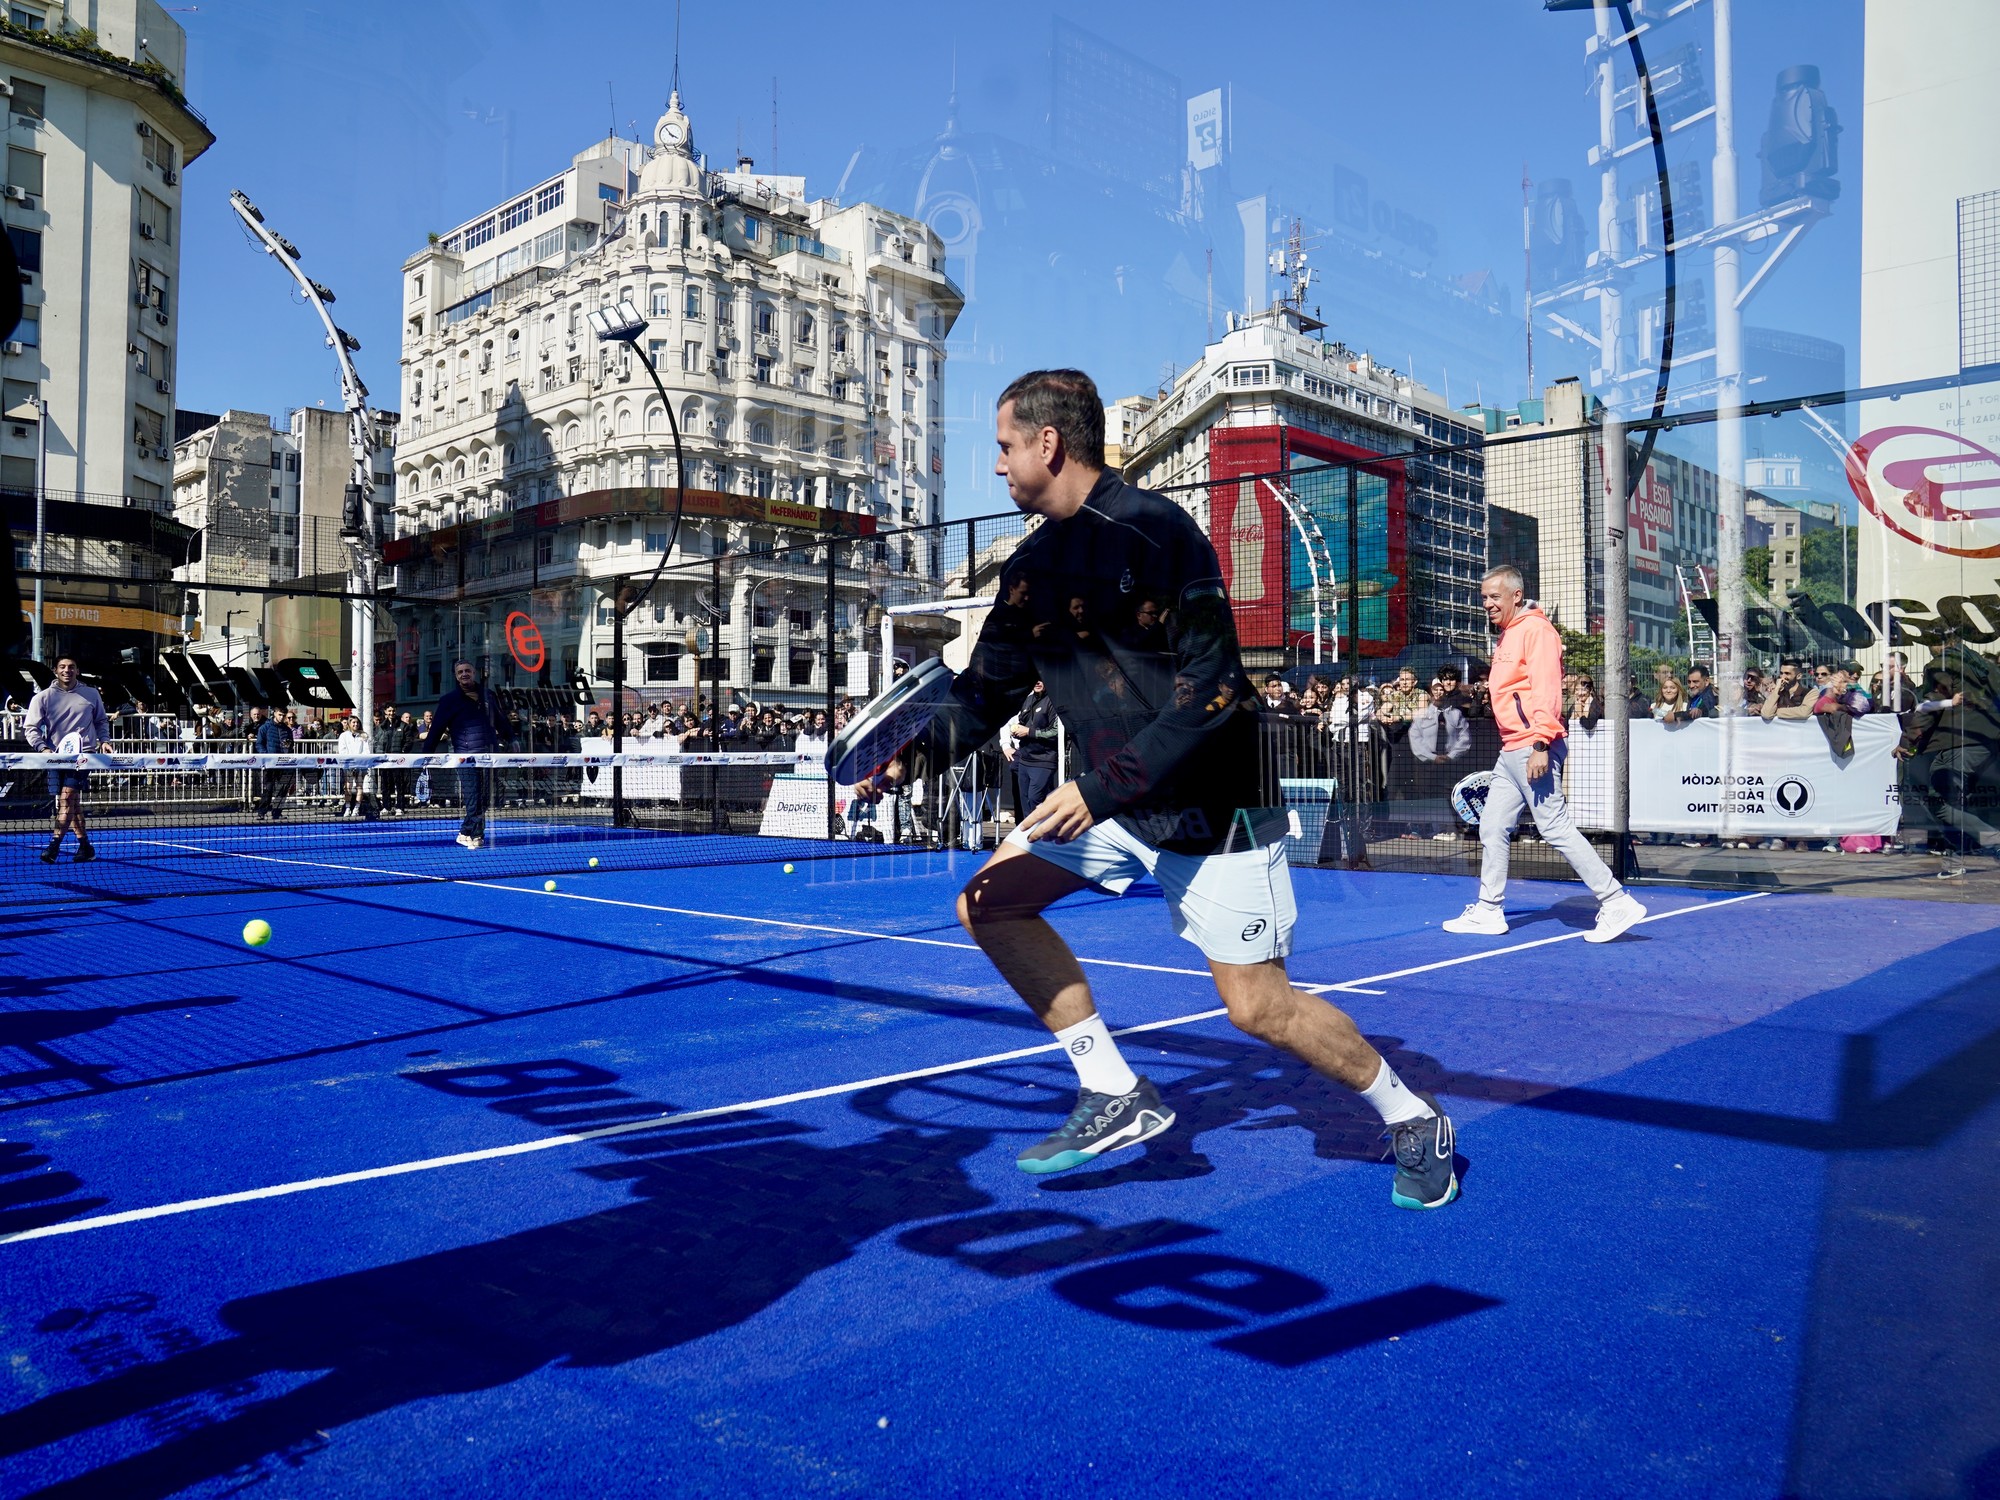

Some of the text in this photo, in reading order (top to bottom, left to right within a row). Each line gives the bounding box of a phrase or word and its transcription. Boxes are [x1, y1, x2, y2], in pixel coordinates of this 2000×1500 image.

[1939, 402, 1952, 411] EN
[1946, 418, 1966, 428] FUE
[668, 495, 720, 508] MALLISTER
[1652, 484, 1671, 508] ESTÁ
[770, 504, 817, 522] McFERNÁNDEZ
[1640, 500, 1672, 529] PASANDO
[167, 757, 180, 765] BA
[777, 801, 817, 814] Deportes
